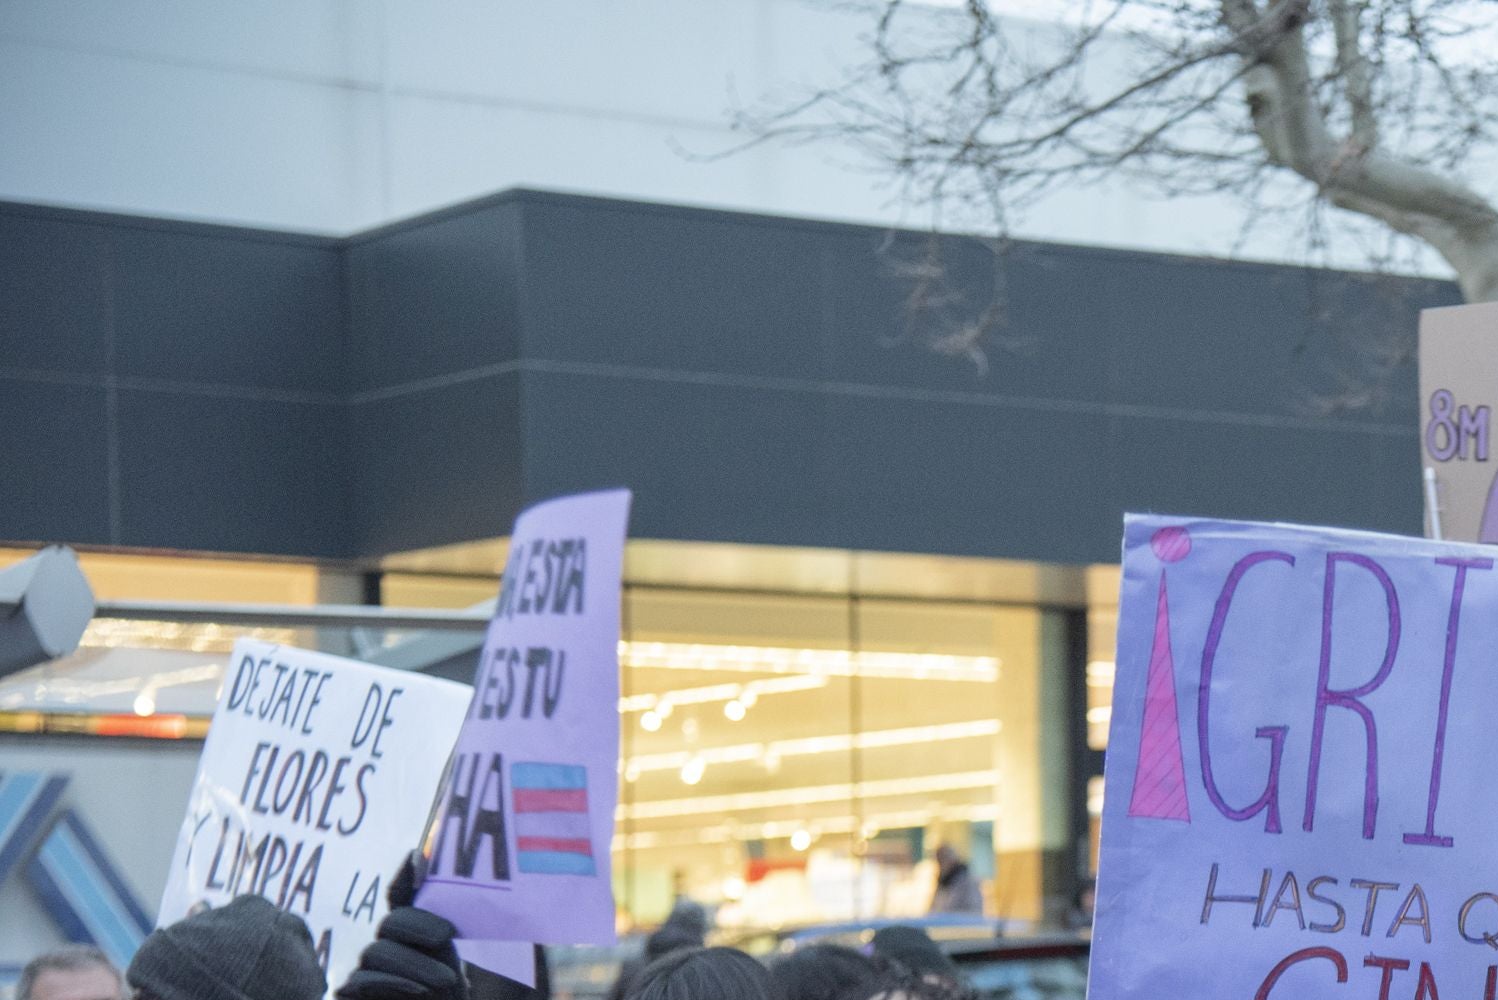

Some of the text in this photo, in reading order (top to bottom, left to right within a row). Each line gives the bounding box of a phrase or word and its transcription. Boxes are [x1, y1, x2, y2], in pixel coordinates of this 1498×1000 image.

[1424, 388, 1491, 462] 8M
[350, 679, 405, 759] DE
[239, 741, 377, 838] FLORES
[430, 752, 513, 881] HA
[205, 817, 325, 914] LIMPIA
[342, 871, 382, 924] LA
[1200, 862, 1433, 944] HASTA
